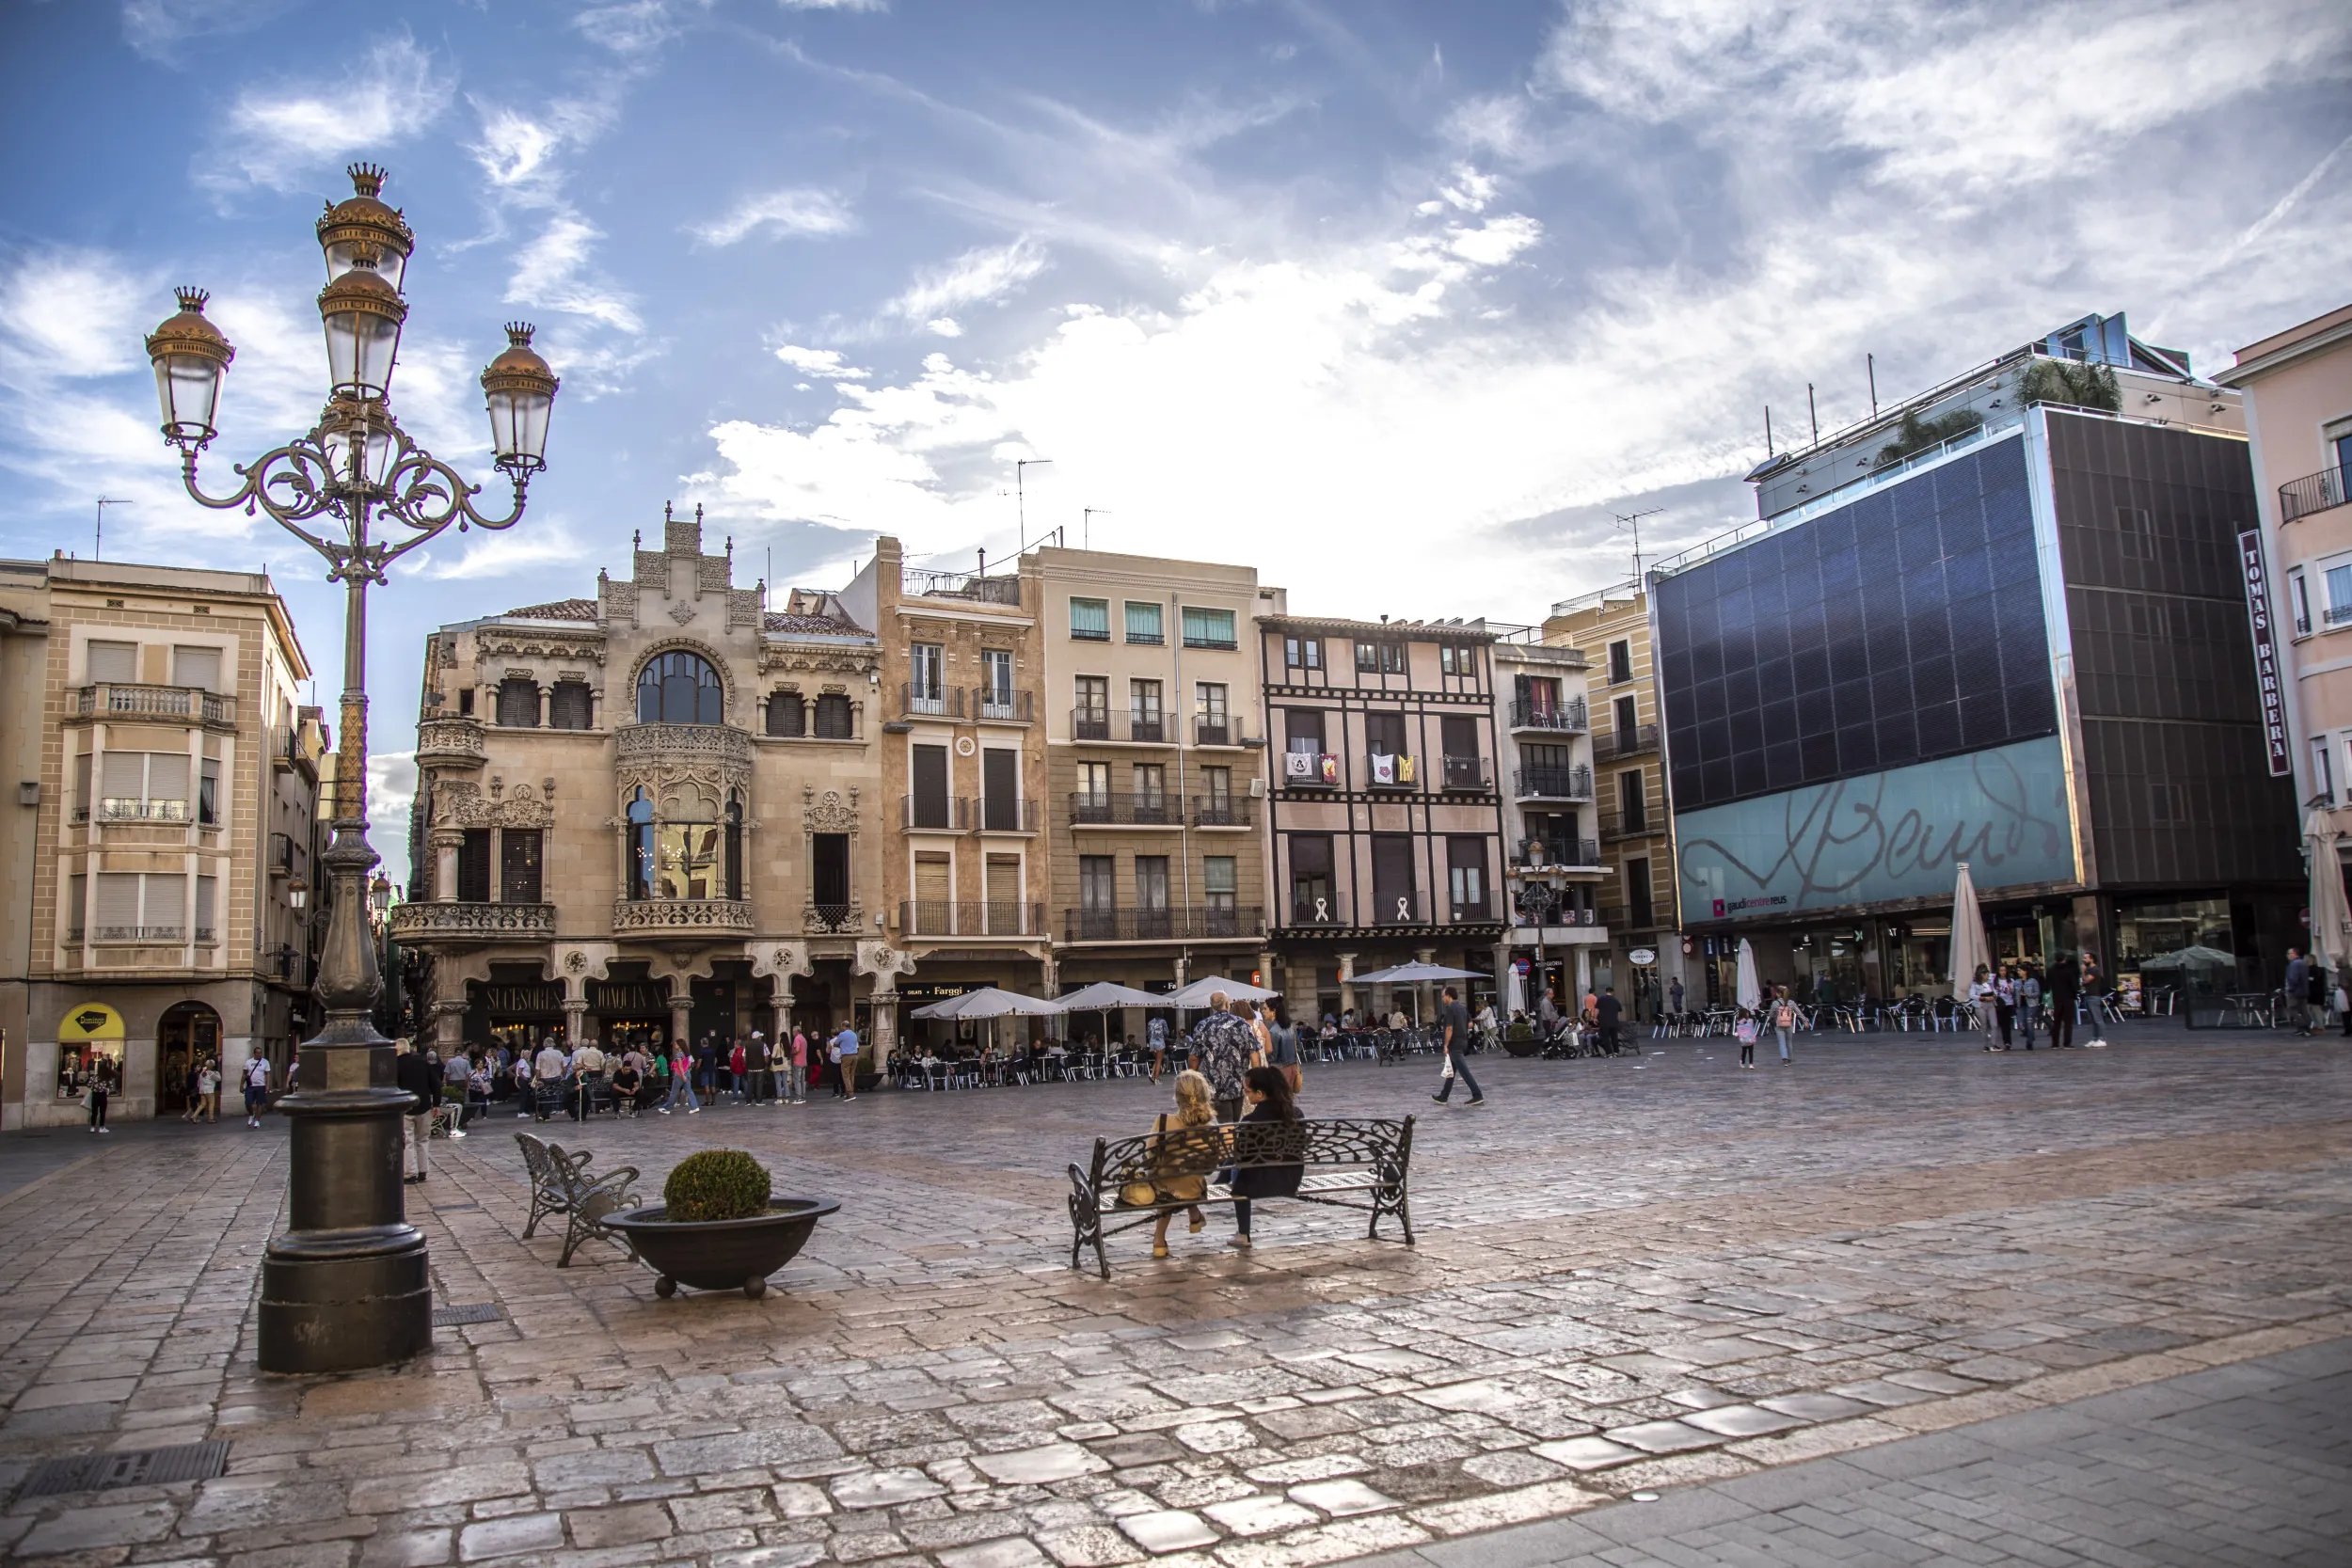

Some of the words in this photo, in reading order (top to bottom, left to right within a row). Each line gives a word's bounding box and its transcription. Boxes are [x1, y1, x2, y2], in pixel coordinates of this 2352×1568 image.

[933, 986, 962, 996] Farggi
[487, 987, 565, 1011] SUCESORES
[80, 1016, 105, 1026] Domingo
